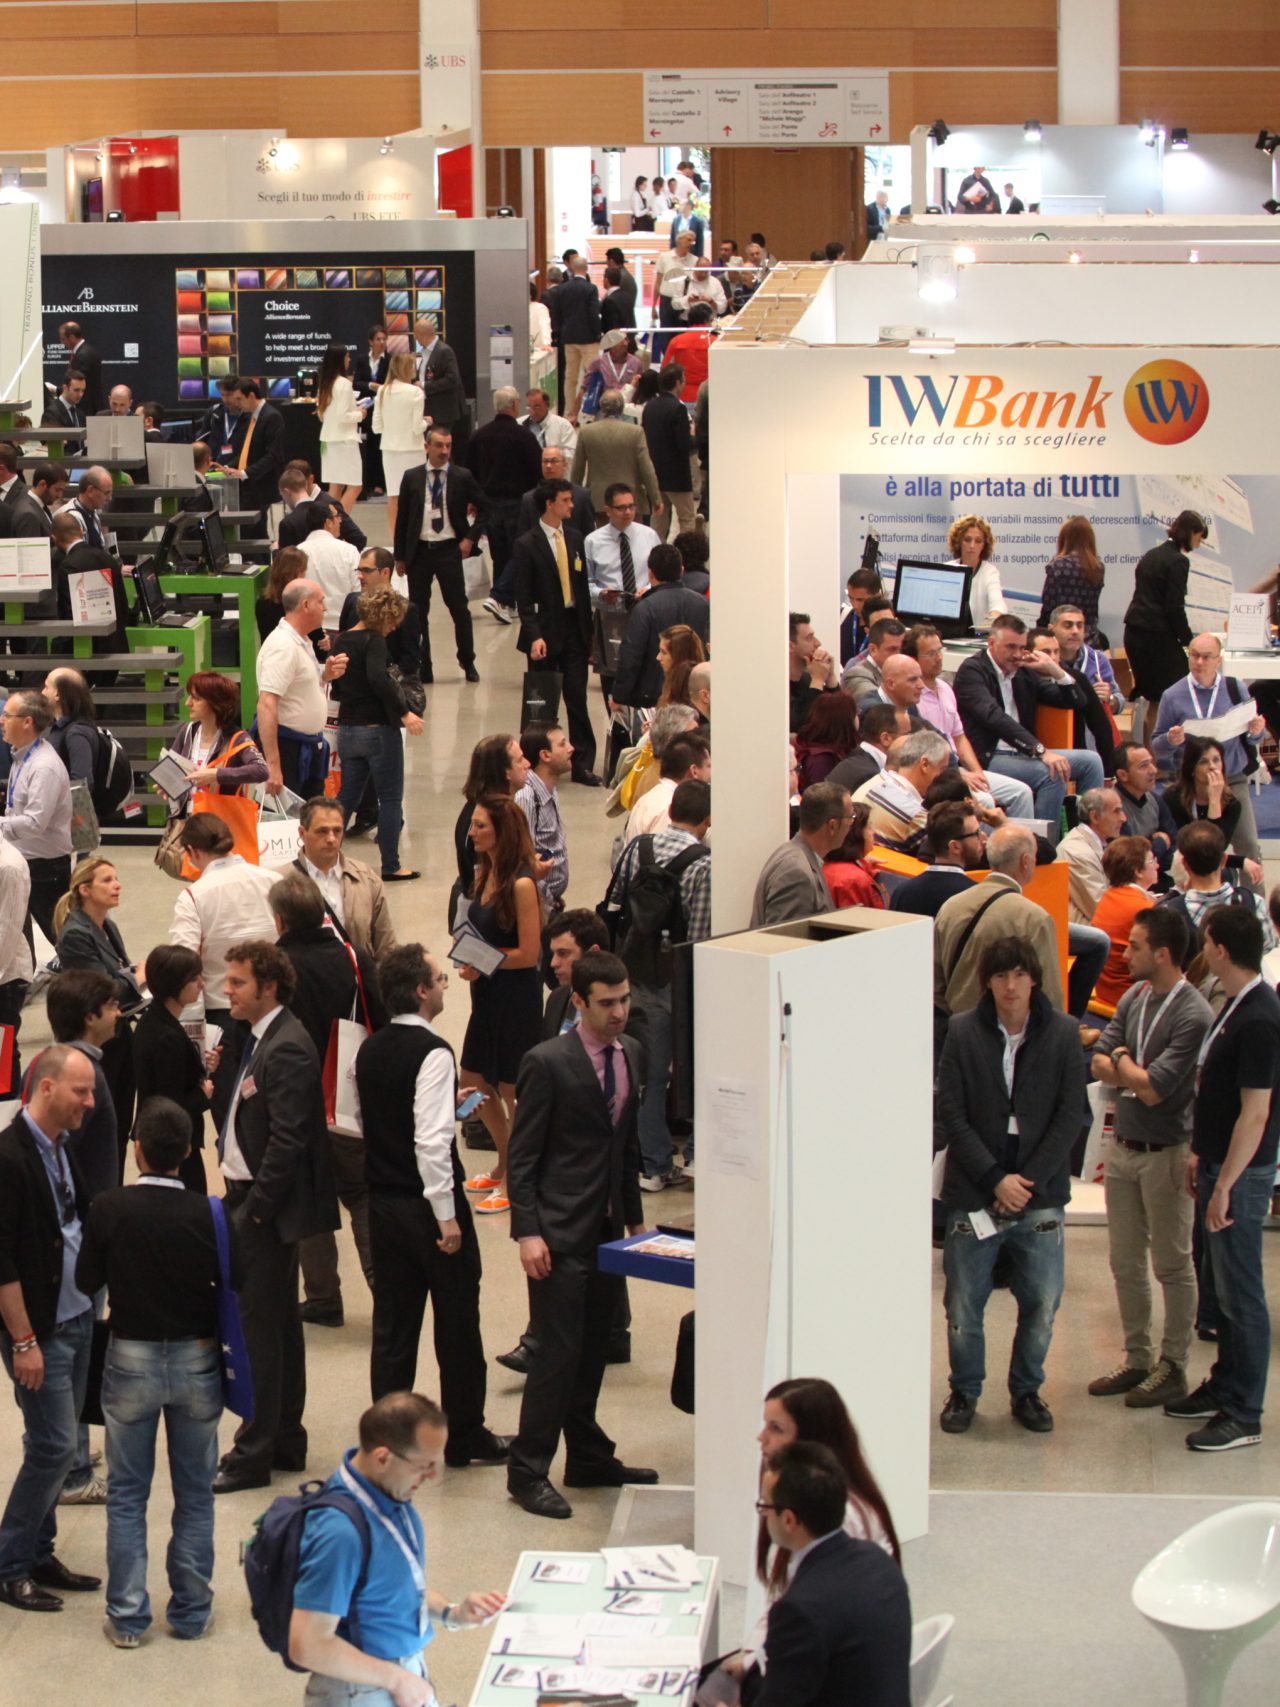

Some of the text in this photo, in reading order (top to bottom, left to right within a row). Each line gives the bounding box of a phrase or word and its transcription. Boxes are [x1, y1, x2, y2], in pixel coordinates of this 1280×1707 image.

[441, 55, 466, 67] UBS
[649, 96, 684, 104] Morningstar
[718, 96, 738, 104] Village
[649, 118, 685, 126] Morningstar
[257, 191, 413, 203] Scegli il tuo modo di investire
[42, 301, 139, 313] LLIANCEBERNSTEIN
[264, 300, 300, 311] Choice
[271, 332, 287, 340] wide
[288, 333, 306, 341] range
[306, 332, 313, 340] of
[314, 332, 332, 340] funds
[273, 344, 287, 353] help
[862, 374, 1114, 429] IWBank
[1135, 379, 1199, 424] IW
[869, 431, 1107, 450] Scelta da chi sa scegliere
[885, 474, 1120, 501] è alla portata di tutti
[868, 513, 924, 524] Commissioni
[926, 513, 947, 524] fisse
[949, 516, 955, 524] a
[987, 513, 1021, 524] variabili
[1023, 514, 1063, 524] massimo
[1090, 514, 1140, 525] decrescenti
[1143, 516, 1159, 525] con
[899, 553, 931, 563] tecnica
[1011, 554, 1050, 566] supporto
[1104, 554, 1118, 564] del
